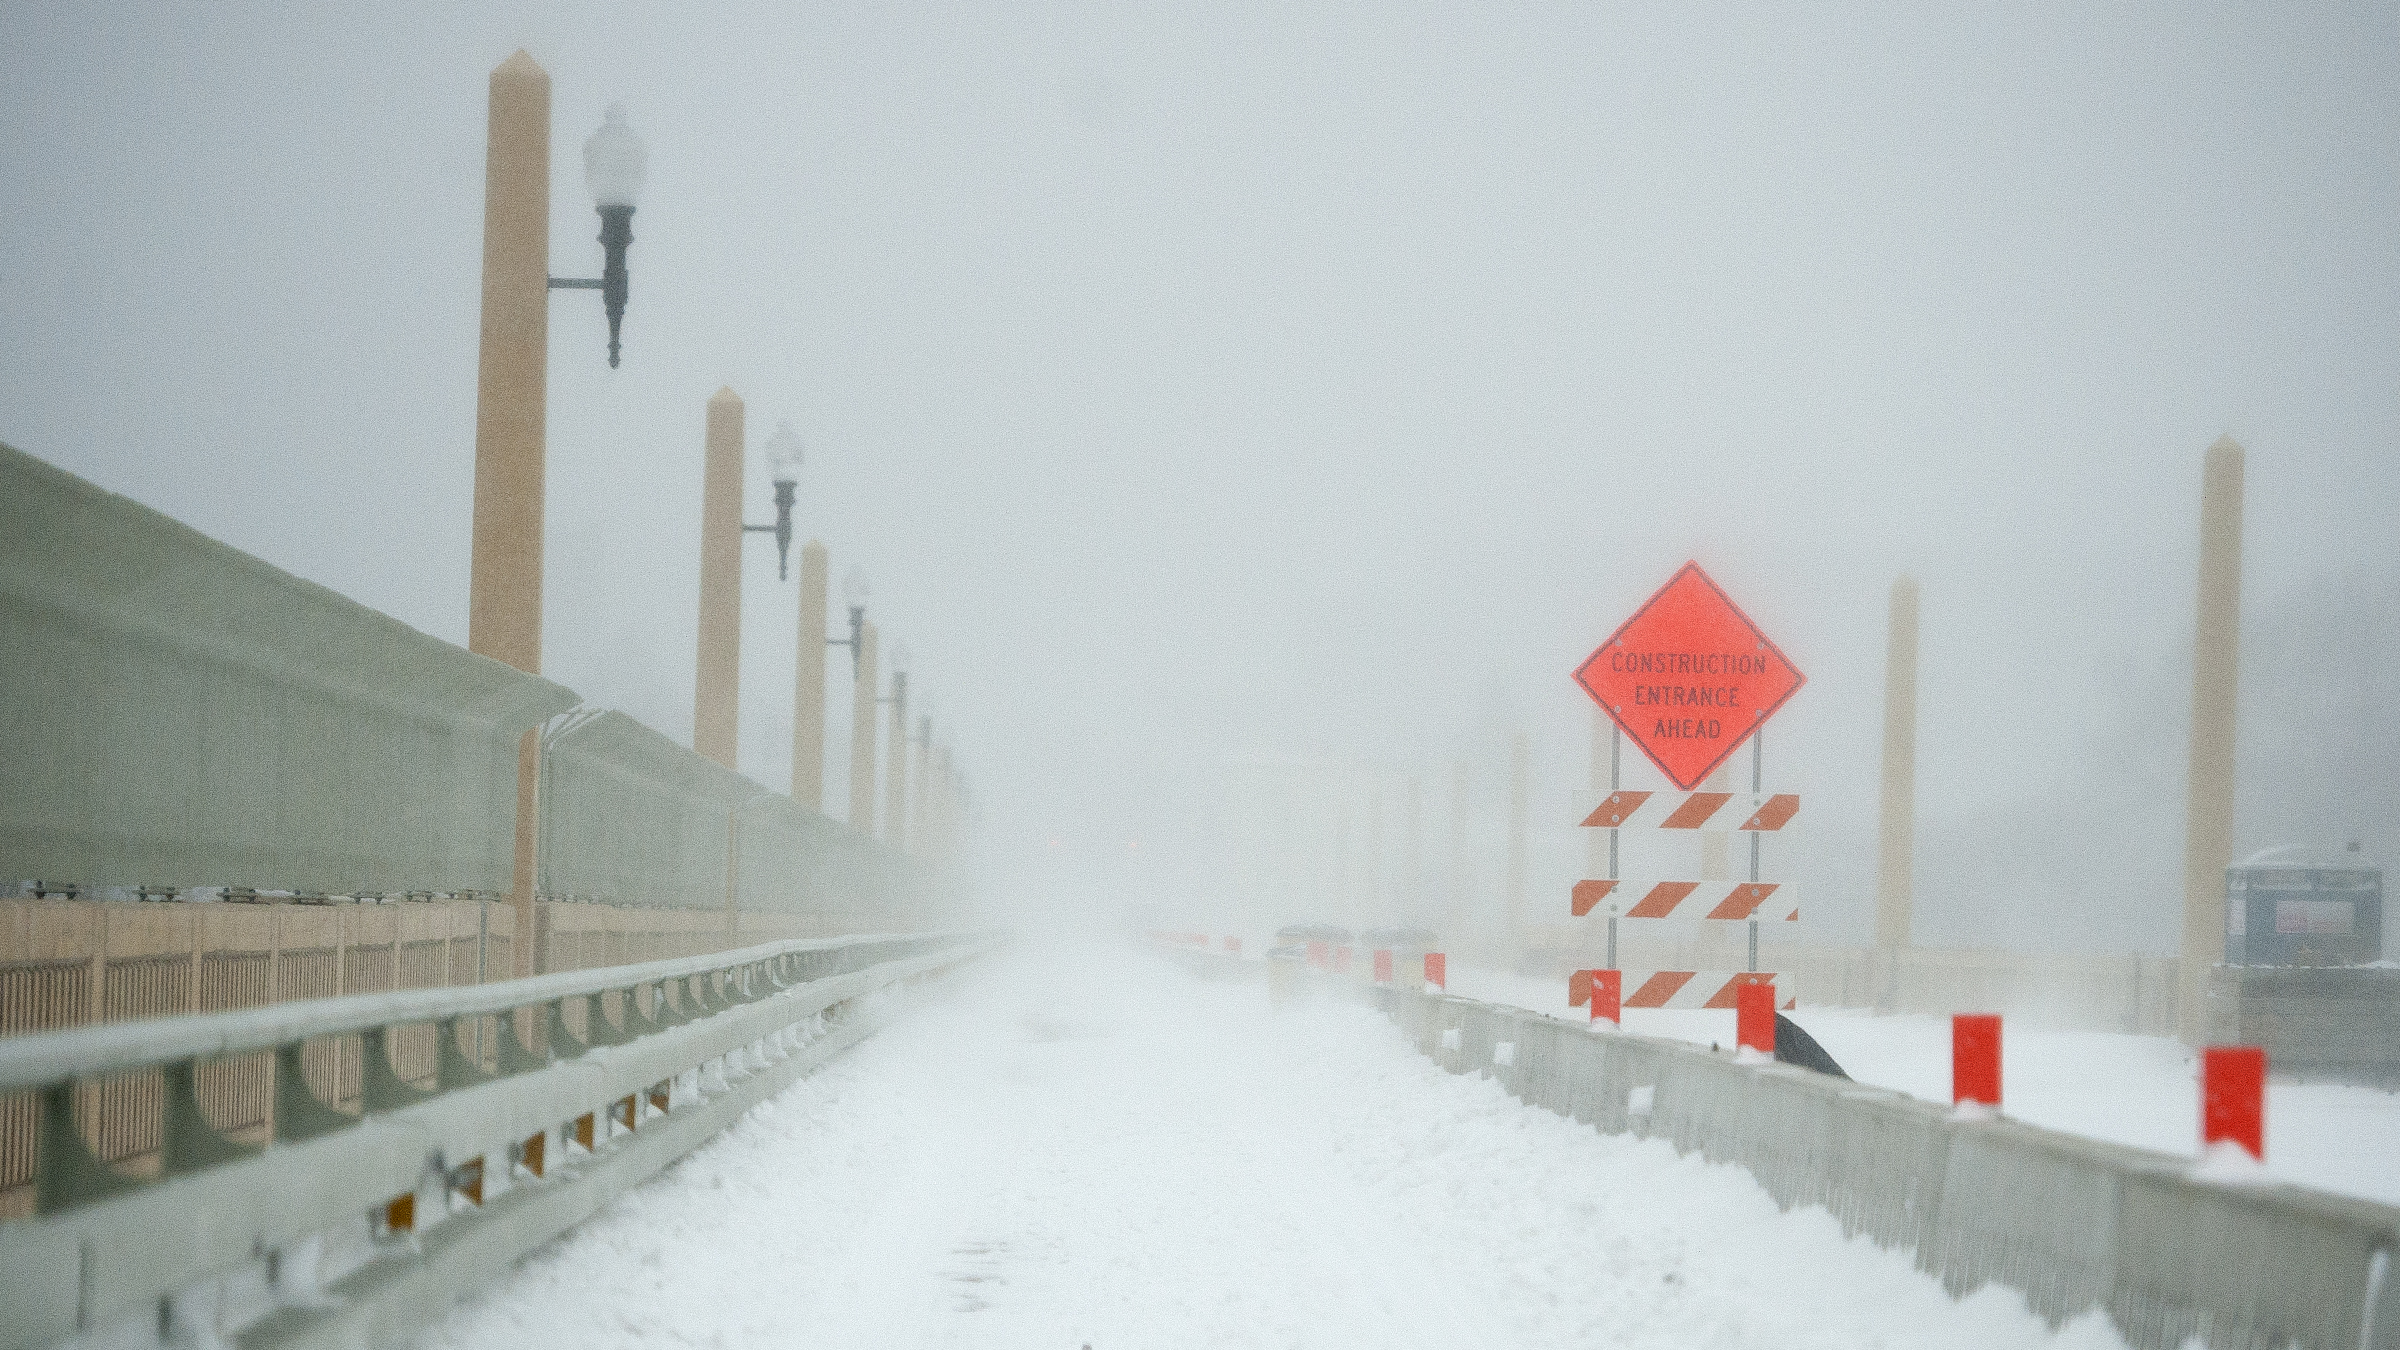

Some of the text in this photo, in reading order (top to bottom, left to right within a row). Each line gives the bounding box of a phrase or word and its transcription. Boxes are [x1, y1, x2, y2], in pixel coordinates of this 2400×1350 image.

[1612, 653, 1766, 674] CONSTRUCTION
[1635, 686, 1740, 707] ENTRANCE
[1654, 719, 1721, 739] AHEAD
